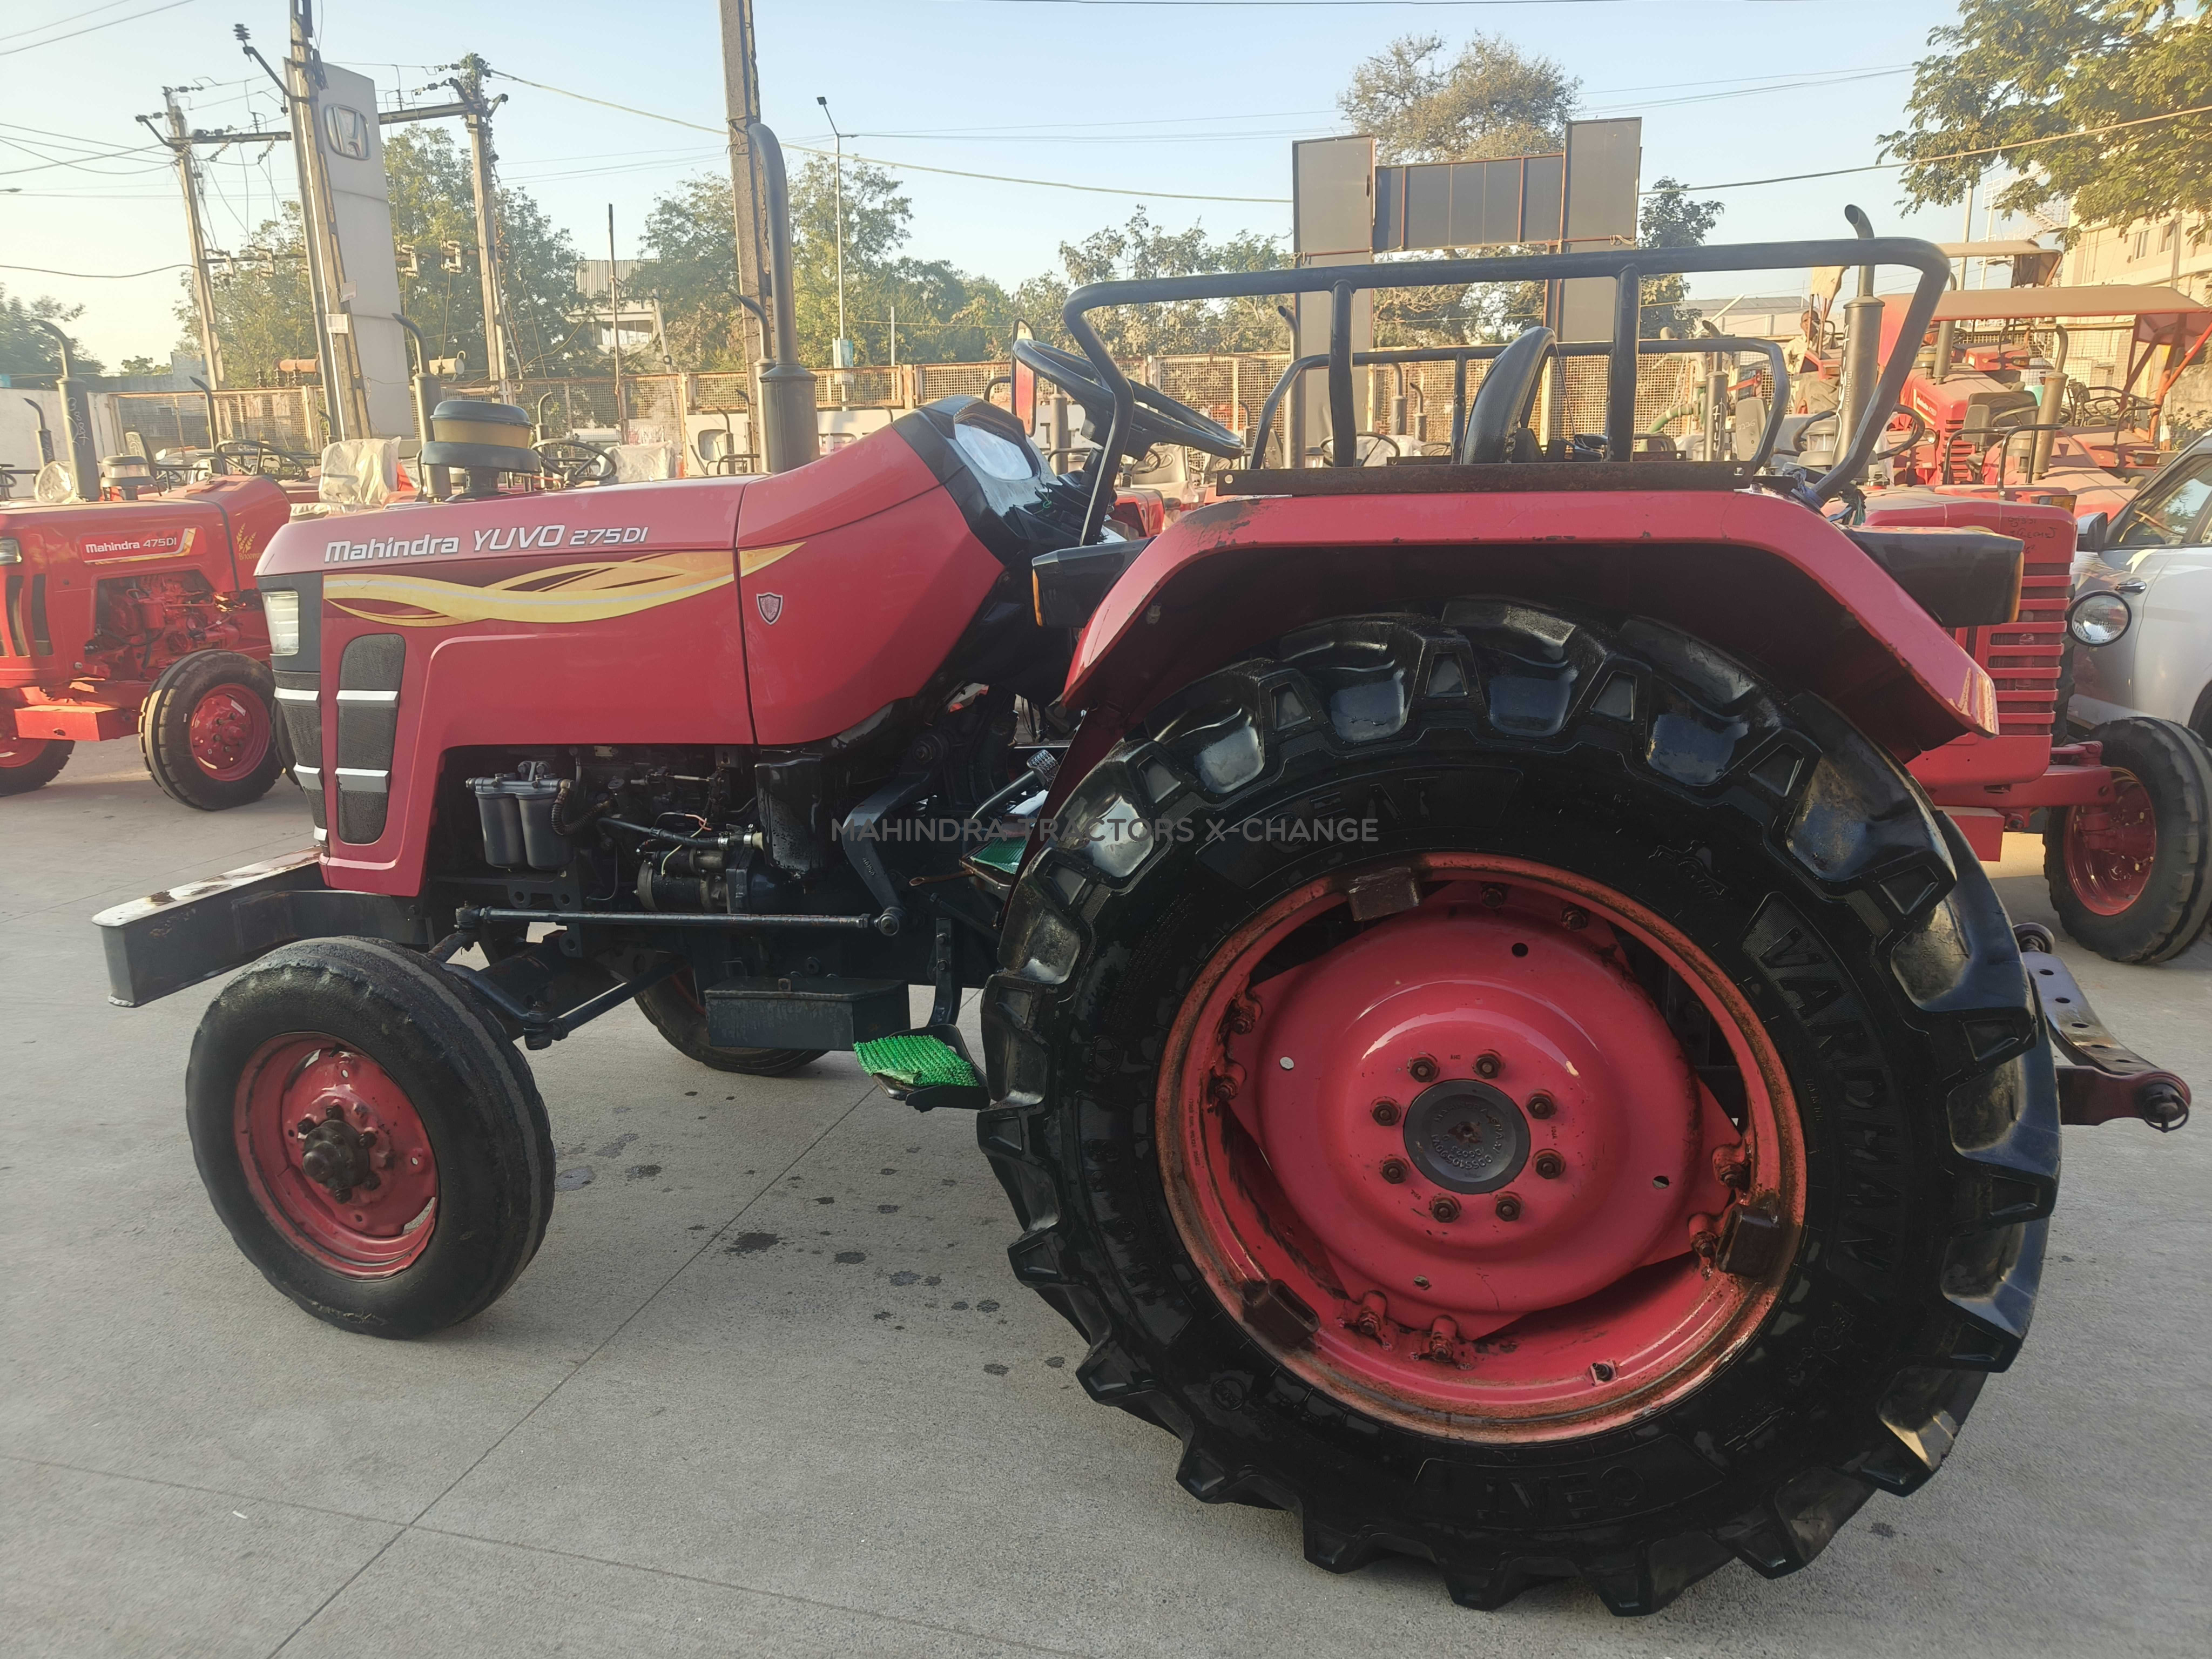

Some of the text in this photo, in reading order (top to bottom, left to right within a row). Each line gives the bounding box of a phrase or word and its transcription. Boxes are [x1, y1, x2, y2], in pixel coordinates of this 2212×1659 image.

[85, 537, 177, 553] Mahindra 475DI
[325, 525, 648, 563] Mahindra YUVO 275DI
